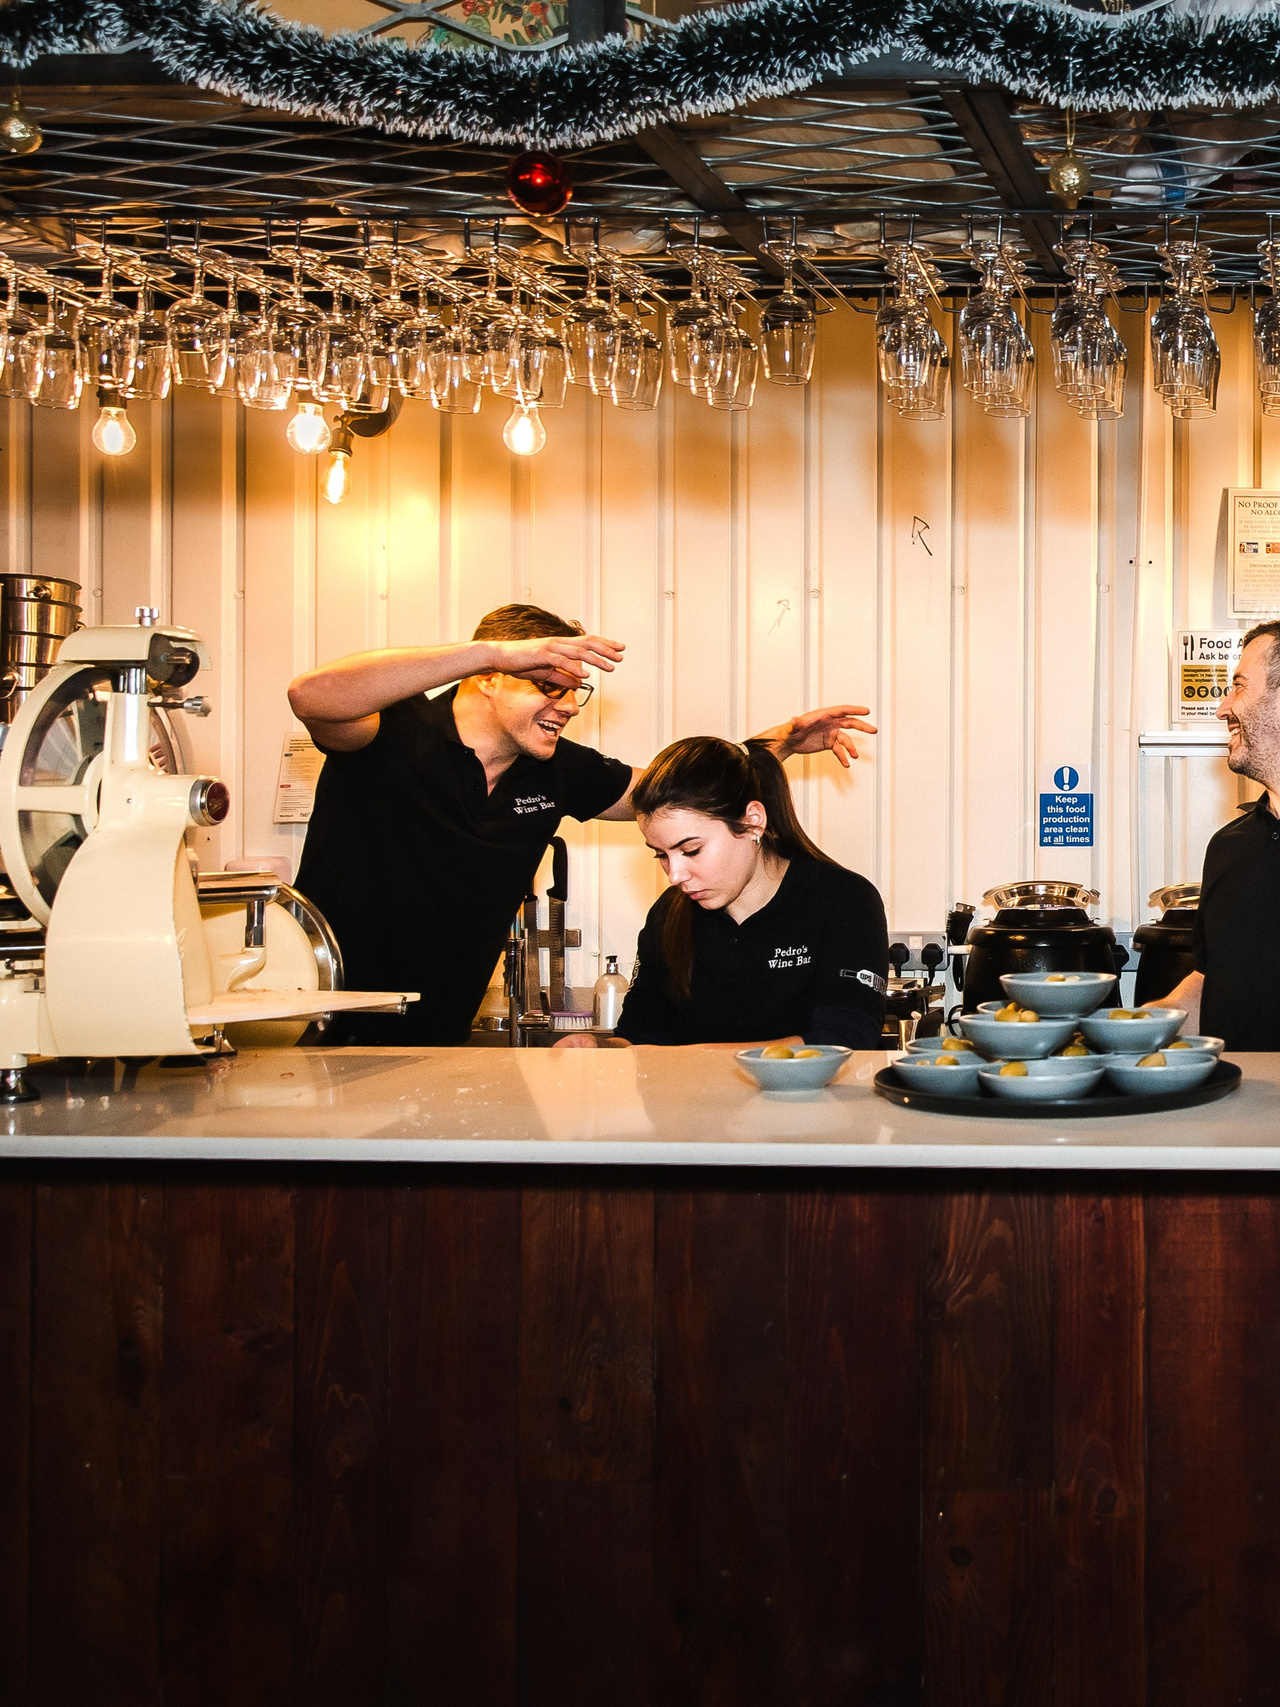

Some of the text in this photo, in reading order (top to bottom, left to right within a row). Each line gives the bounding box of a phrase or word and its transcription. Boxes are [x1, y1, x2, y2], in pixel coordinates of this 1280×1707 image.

[1199, 638, 1232, 649] Food
[1199, 652, 1241, 660] Ask beor
[515, 794, 546, 806] Pedro's
[1055, 795, 1078, 804] Keep
[513, 801, 555, 814] Wine Bar
[1043, 816, 1090, 824] production
[1065, 825, 1089, 833] clean
[1053, 835, 1064, 844] all
[1066, 835, 1090, 843] times
[774, 945, 808, 958] Pedro's
[768, 956, 811, 969] Wine Bar
